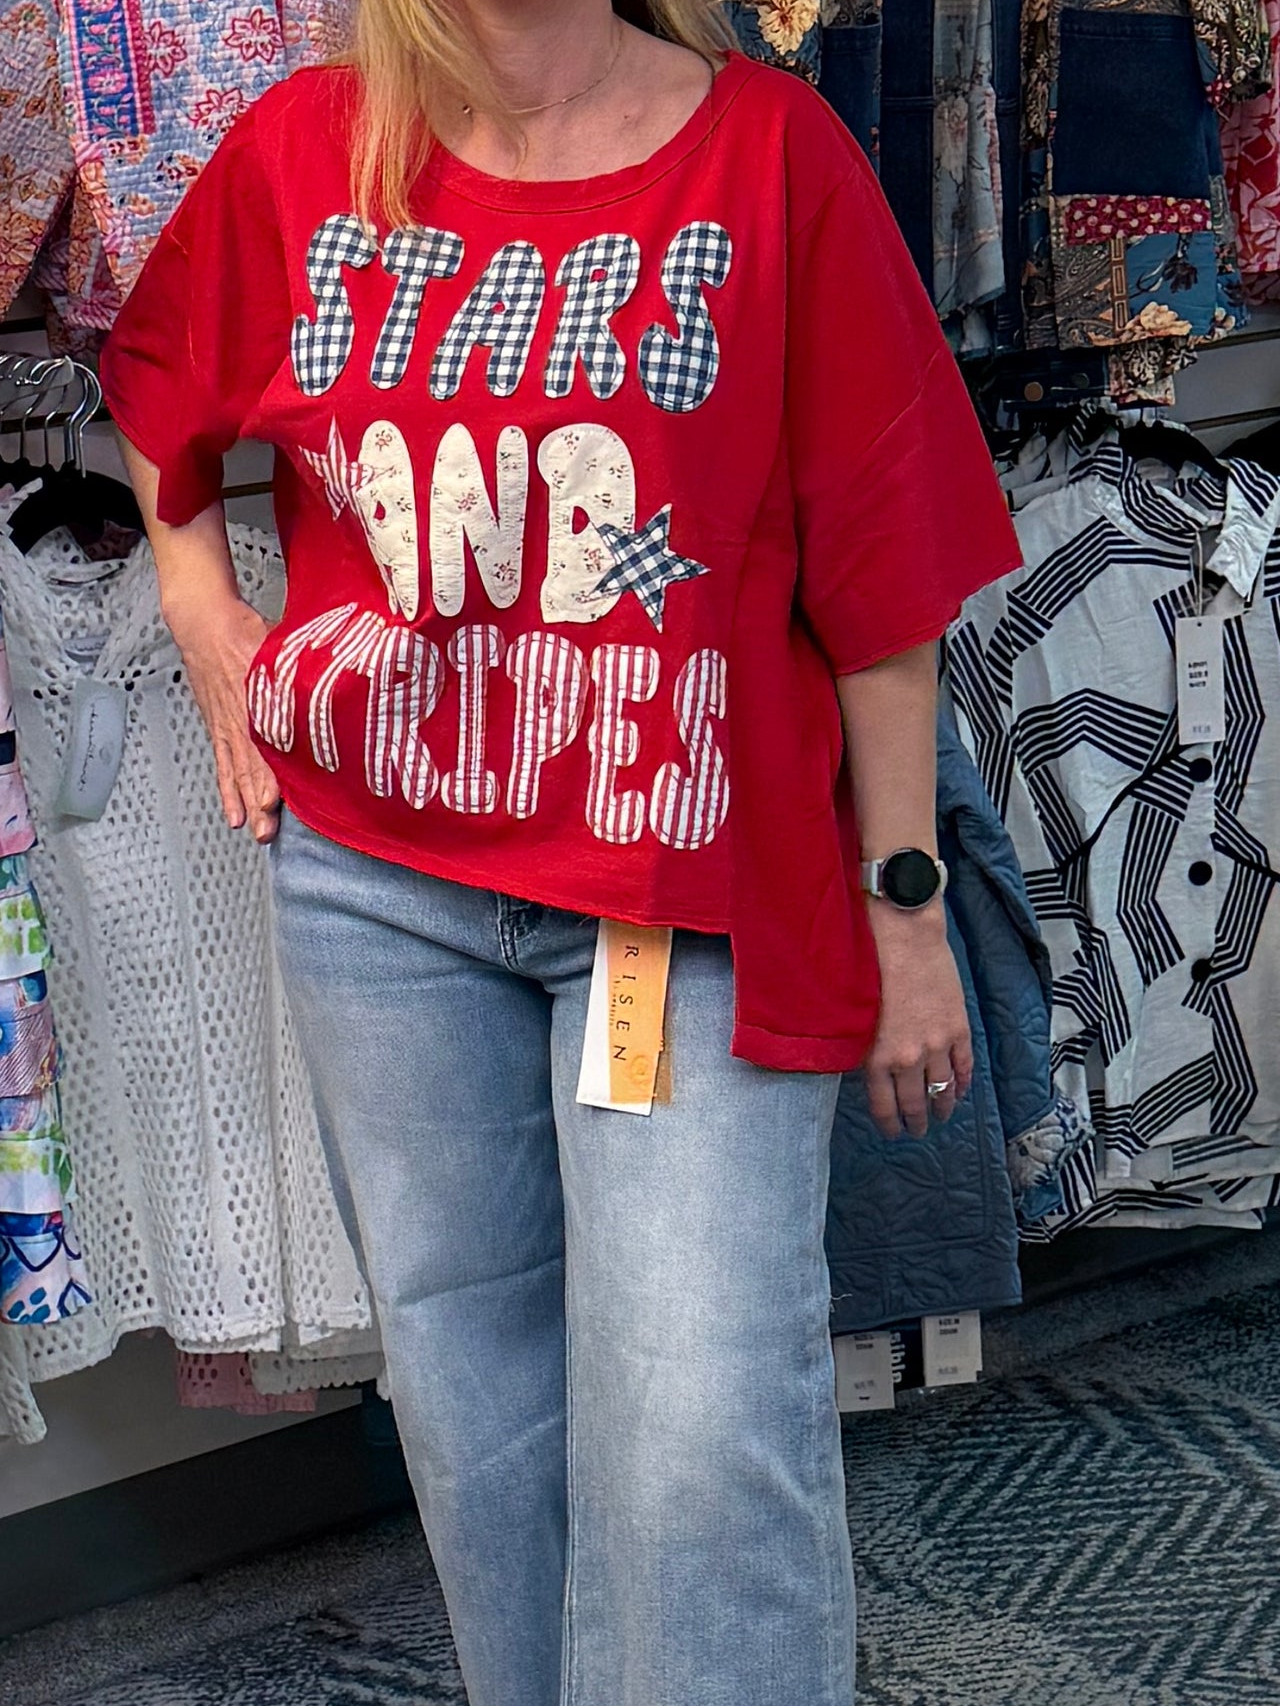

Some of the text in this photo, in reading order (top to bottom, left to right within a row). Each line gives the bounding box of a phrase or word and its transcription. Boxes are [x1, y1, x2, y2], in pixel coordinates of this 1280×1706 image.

[291, 213, 732, 414] STARS
[350, 420, 639, 626] AND
[248, 602, 731, 851] STRIPES
[613, 944, 640, 1061] RISEN
